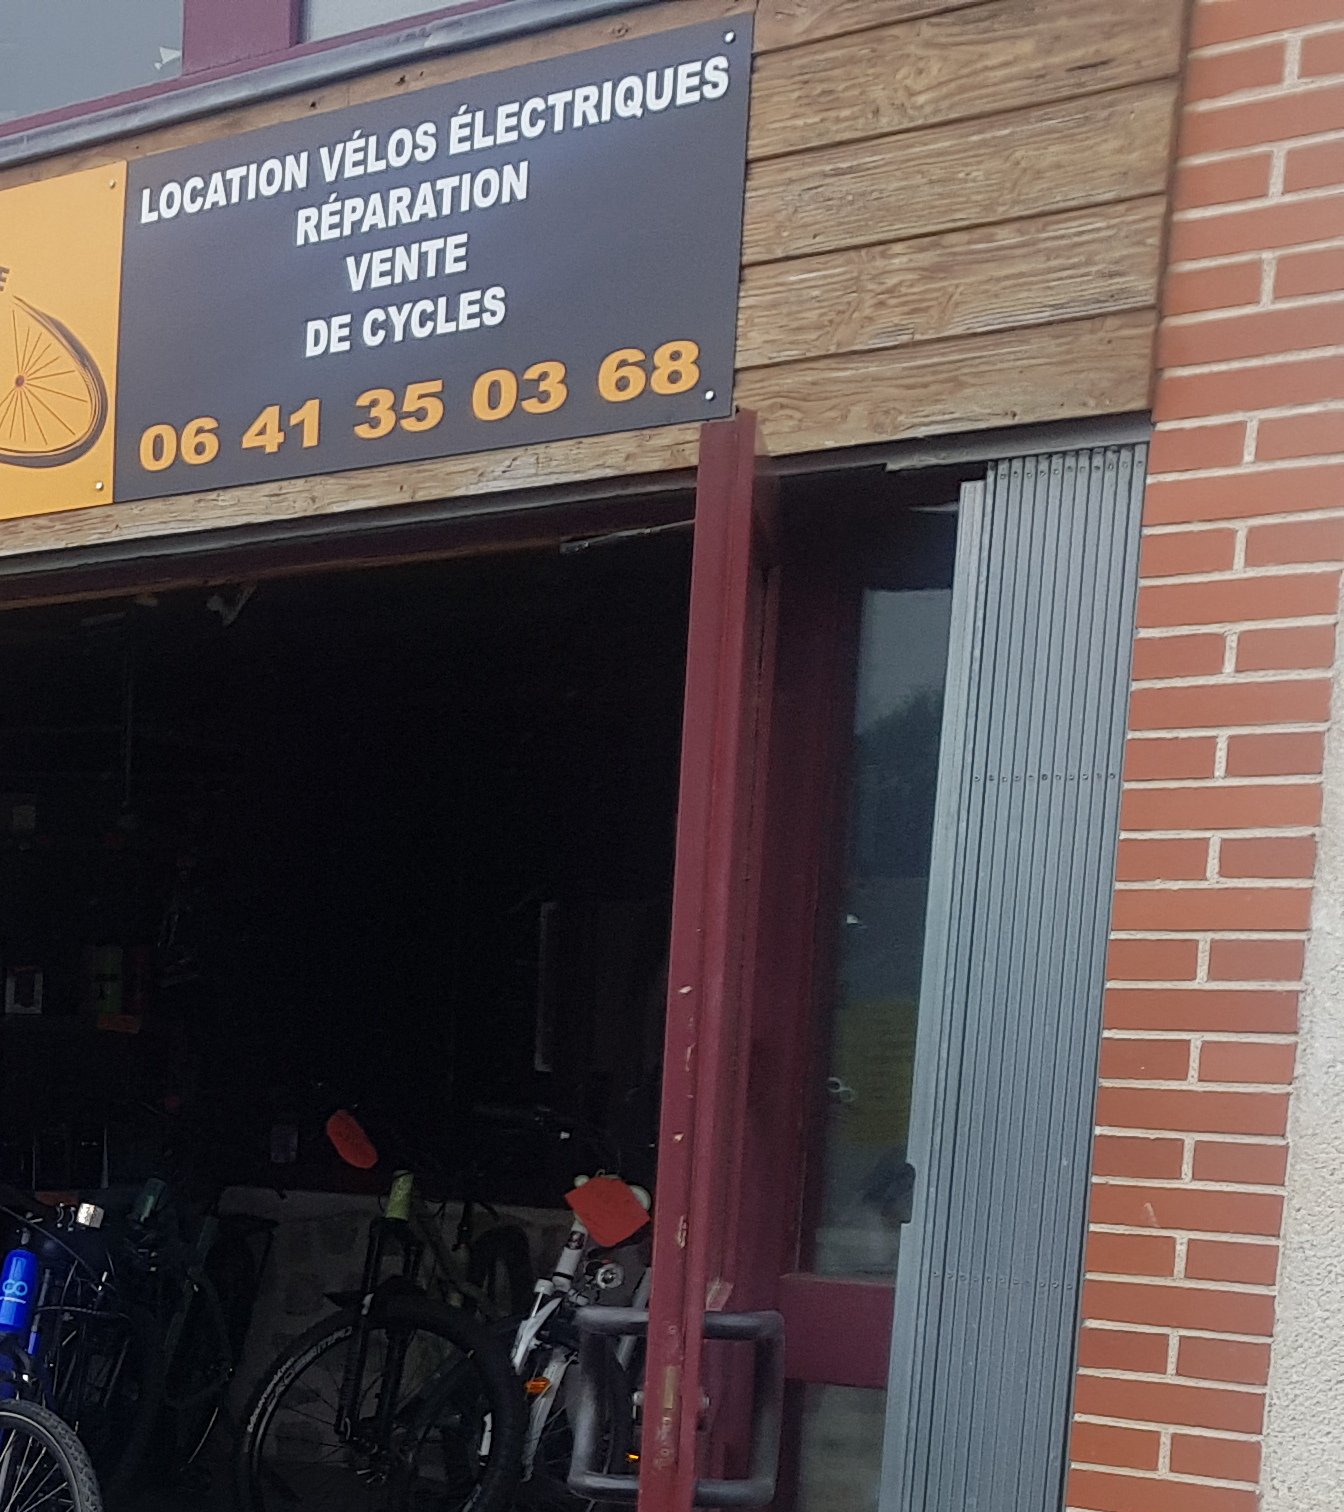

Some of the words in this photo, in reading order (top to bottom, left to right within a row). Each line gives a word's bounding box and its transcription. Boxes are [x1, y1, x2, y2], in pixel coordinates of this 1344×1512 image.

[140, 151, 309, 225] LOCATION
[319, 122, 436, 184] VÉLOS
[448, 55, 729, 157] ÉLECTRIQUES
[296, 161, 530, 245] RÉPARATION
[346, 232, 468, 292] VENTE
[305, 315, 351, 357] DE
[363, 287, 506, 347] CYCLES
[139, 417, 219, 471] 06
[242, 399, 321, 454] 41
[354, 380, 445, 439] 35
[472, 361, 568, 421] 03
[598, 340, 701, 403] 68
